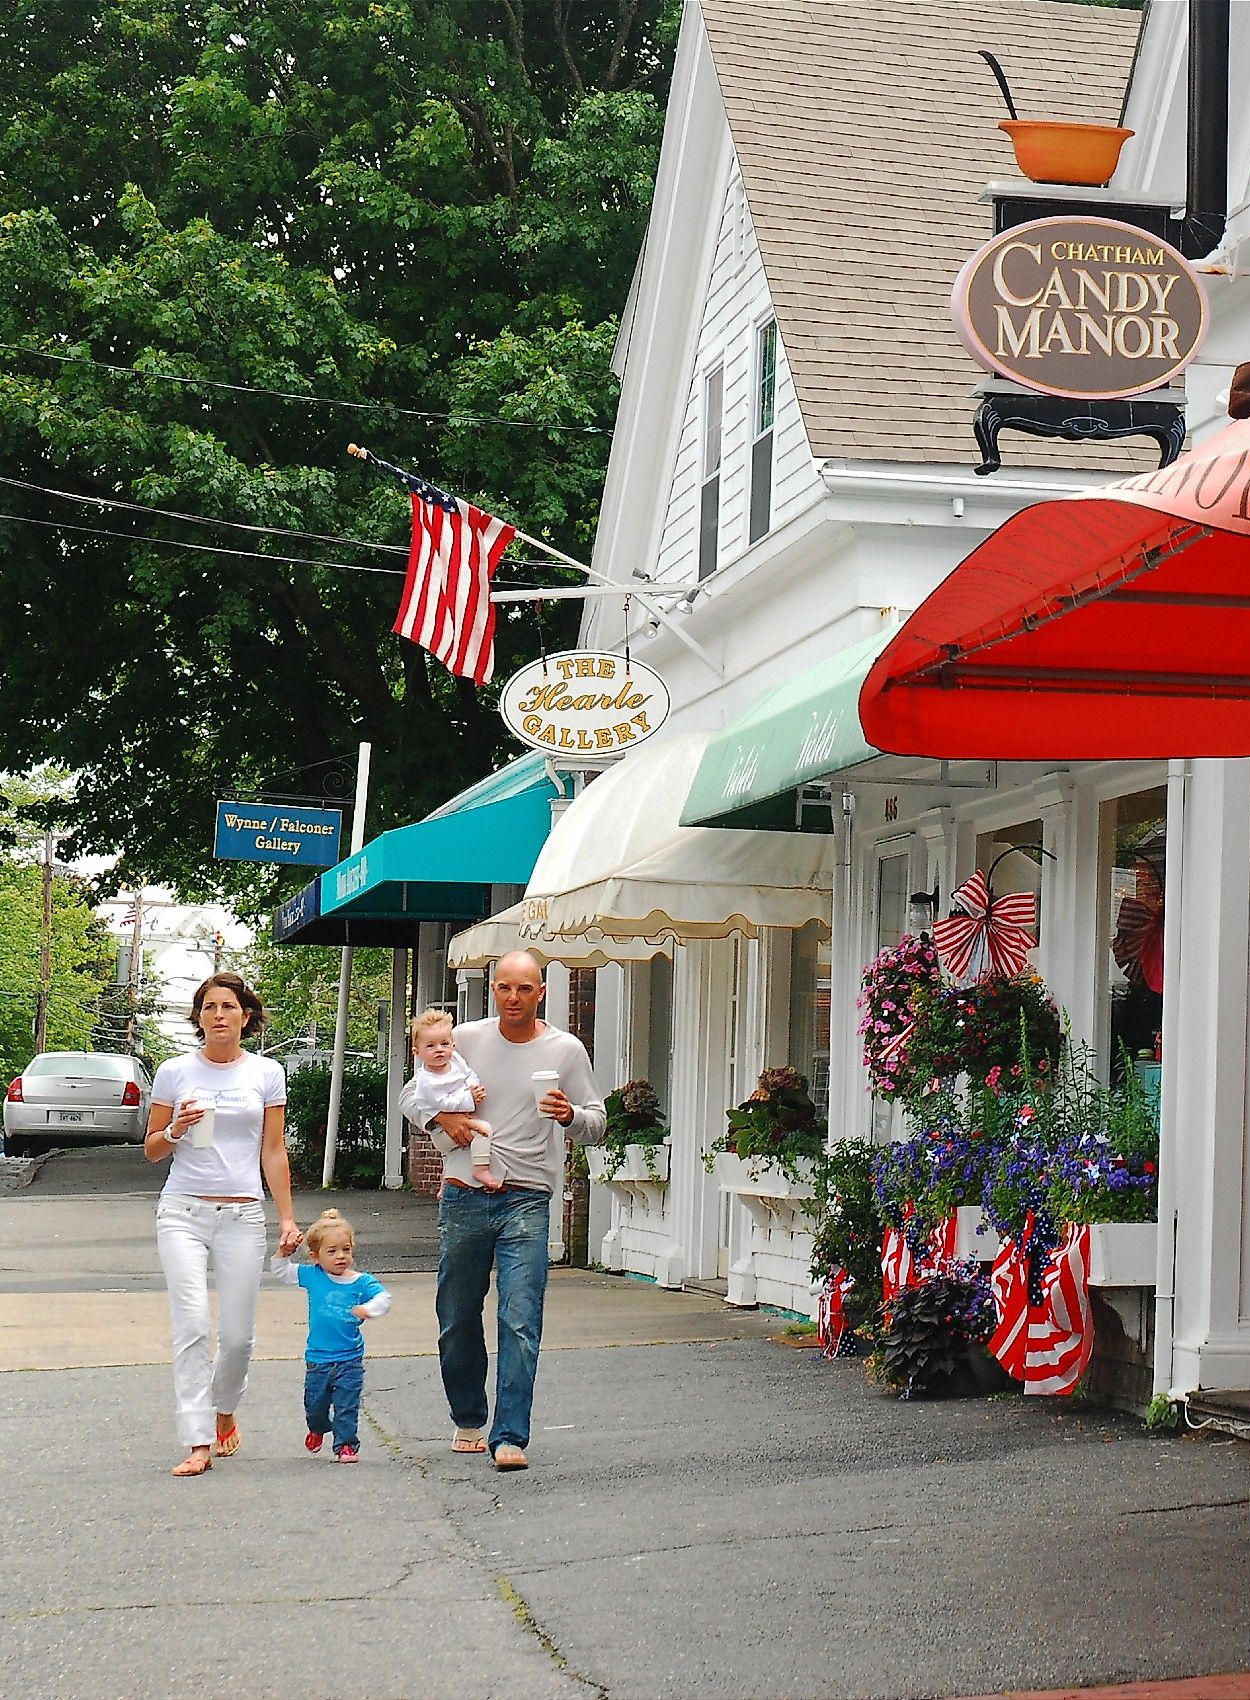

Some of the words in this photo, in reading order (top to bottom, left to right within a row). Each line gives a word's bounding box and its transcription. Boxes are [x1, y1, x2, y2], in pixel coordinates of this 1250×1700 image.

[1050, 241, 1166, 267] CHATHAM
[993, 241, 1180, 316] CANDY
[993, 304, 1182, 360] MANOR
[556, 657, 616, 680] THE
[518, 681, 654, 713] Hearle
[522, 710, 652, 749] GALLERY
[224, 813, 268, 832] Wynne
[280, 818, 335, 836] Falconer
[255, 835, 301, 855] Gallery
